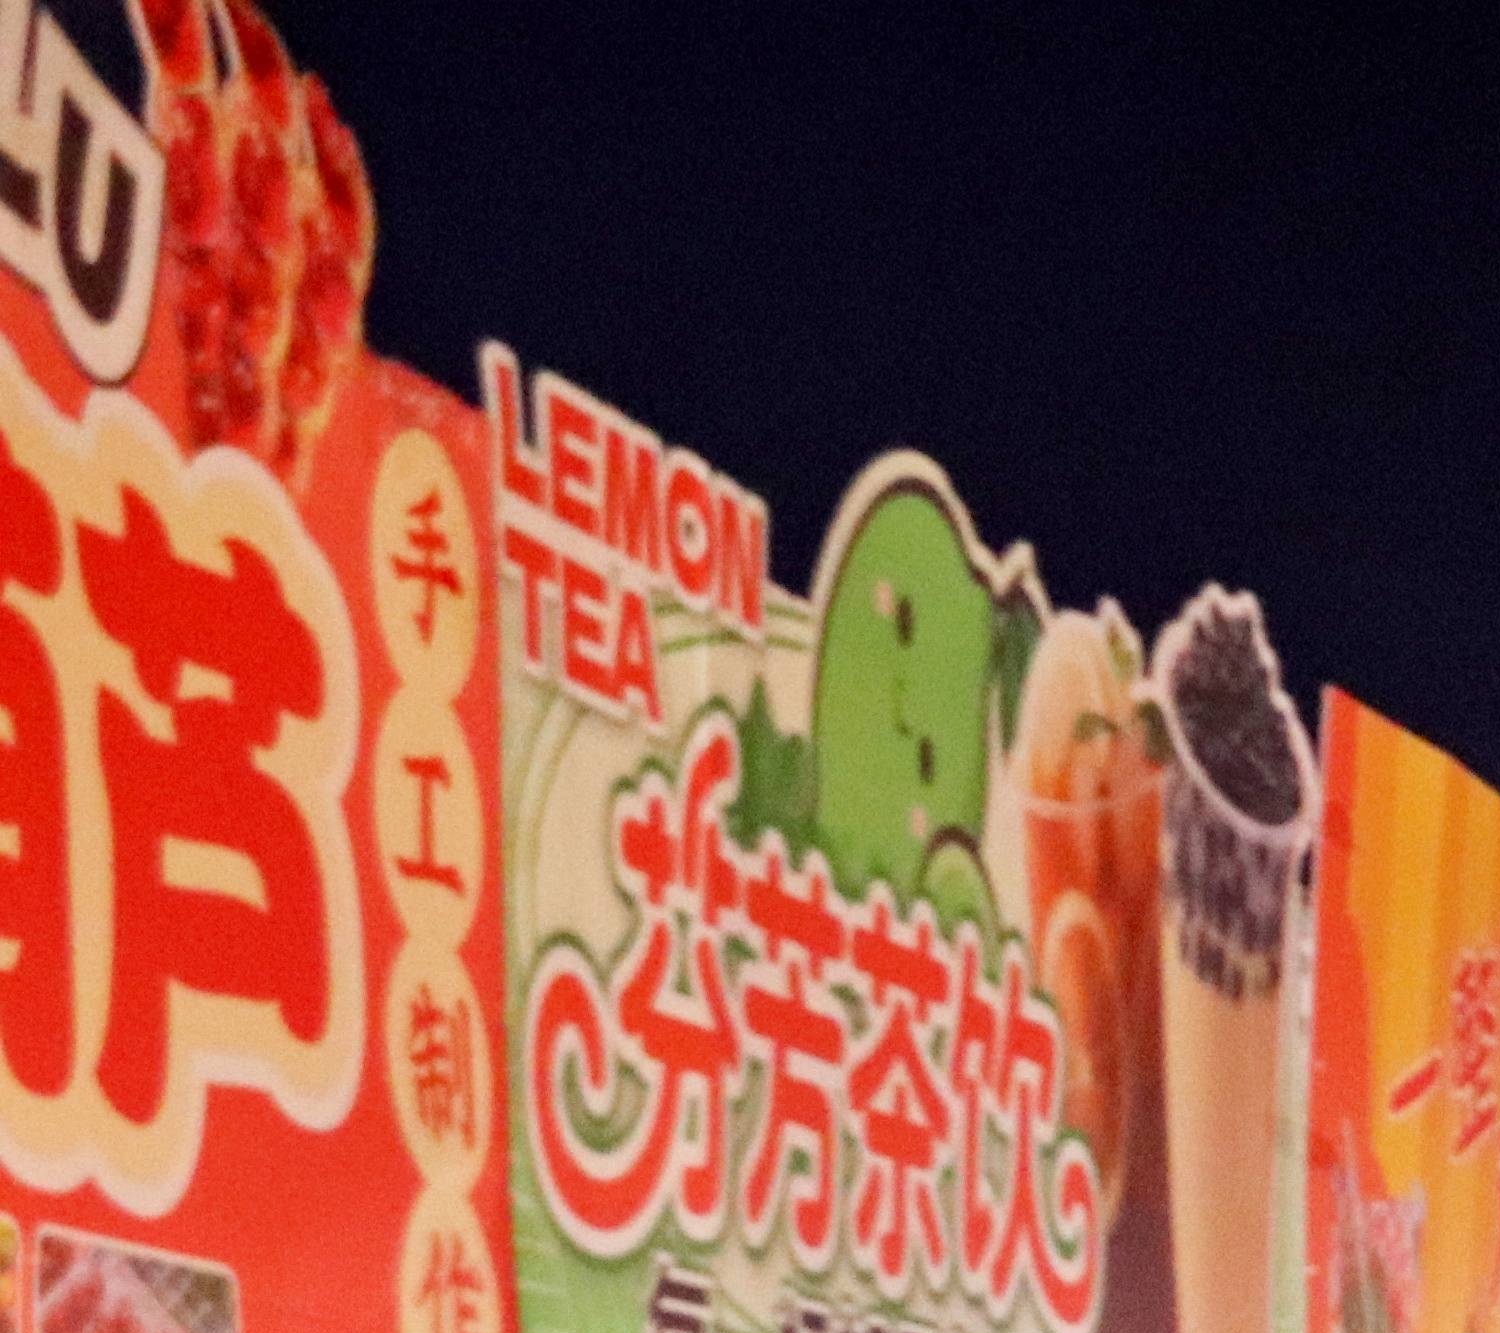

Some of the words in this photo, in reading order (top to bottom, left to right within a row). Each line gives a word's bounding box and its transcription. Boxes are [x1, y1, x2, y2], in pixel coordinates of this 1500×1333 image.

[490, 358, 767, 632] LEMON
[502, 524, 666, 726] TEA
[530, 728, 1100, 1330] 芬芳茶饮
